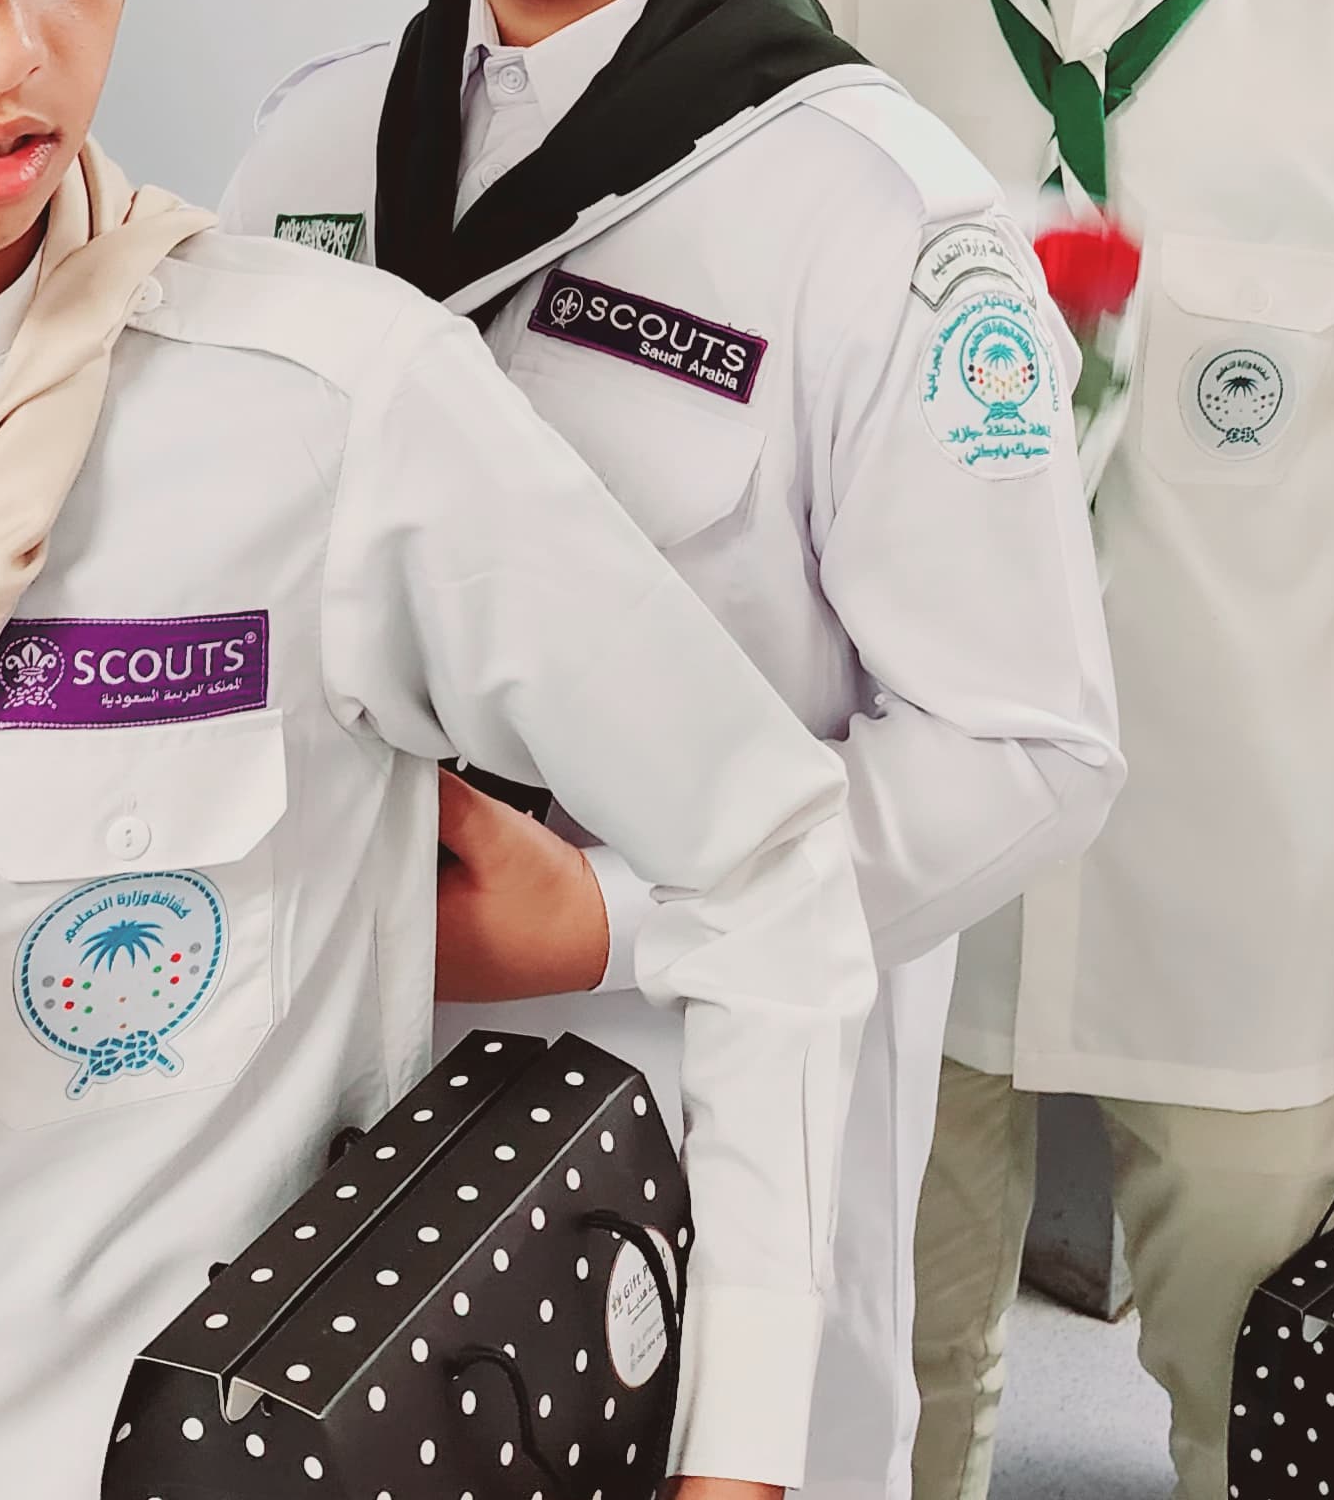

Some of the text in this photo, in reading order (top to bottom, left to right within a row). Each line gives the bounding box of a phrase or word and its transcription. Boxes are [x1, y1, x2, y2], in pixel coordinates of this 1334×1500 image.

[585, 296, 747, 373] SCOUTS
[638, 340, 738, 391] Saudi Arabia
[100, 690, 160, 709] السعودية
[117, 889, 150, 908] وزارة
[64, 895, 115, 944] التعليم
[623, 1273, 642, 1299] Gift
